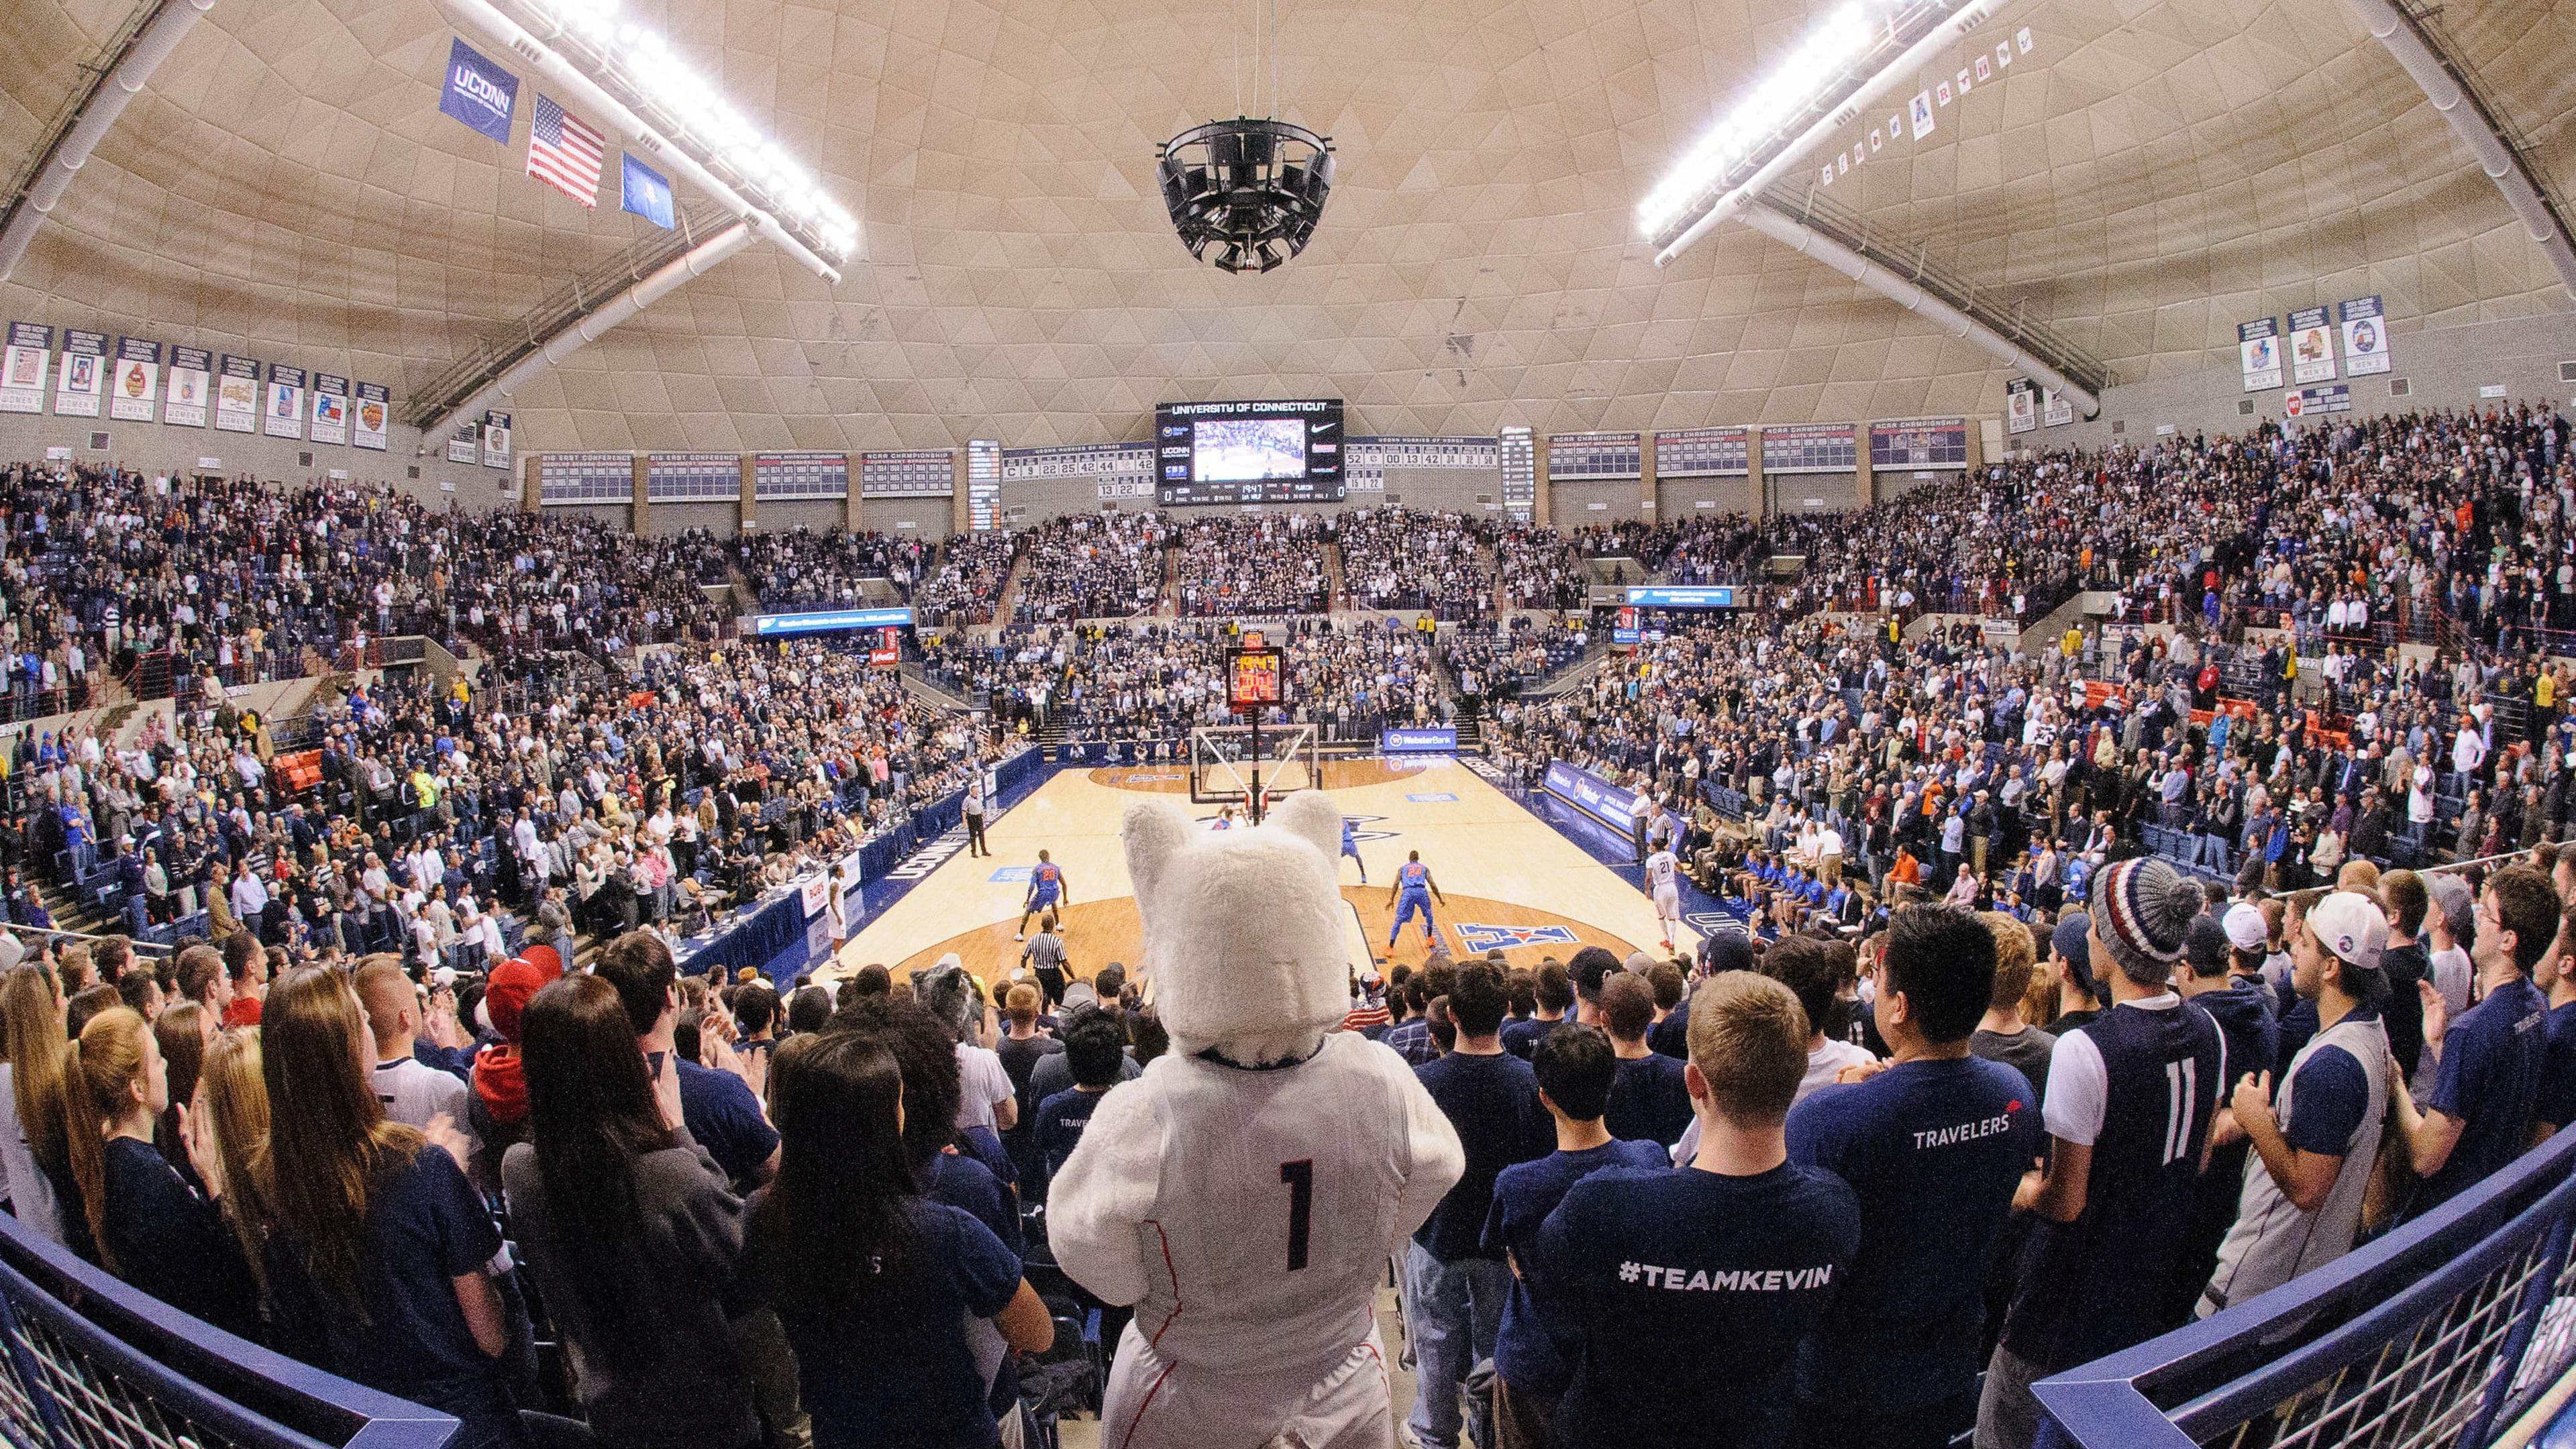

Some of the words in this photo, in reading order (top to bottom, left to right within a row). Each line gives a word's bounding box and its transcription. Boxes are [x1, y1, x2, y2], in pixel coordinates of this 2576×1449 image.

[454, 66, 510, 112] UCONN
[1172, 404, 1234, 415] UNIVERSITY
[1237, 403, 1250, 413] OF
[1253, 402, 1327, 412] CONNECTICUT
[1900, 420, 1959, 428] CHAMPIONSHIP
[1684, 429, 1742, 438] CHAMPIONSHIP
[1348, 455, 1361, 464] 52
[1387, 455, 1400, 463] 00
[1407, 455, 1418, 463] 13
[1426, 455, 1438, 464] 42
[1062, 464, 1075, 473] 25
[1081, 463, 1094, 472] 42
[1100, 462, 1113, 470] 44
[1139, 460, 1152, 469] 42
[1008, 468, 1016, 476] C
[1028, 466, 1033, 475] 9
[1043, 465, 1056, 474] 22
[1370, 479, 1378, 488] 22
[1102, 486, 1112, 495] 13
[1121, 485, 1133, 494] 22
[1243, 484, 1262, 494] 19:47
[1338, 486, 1345, 497] 0
[1165, 490, 1172, 501] 0
[1240, 655, 1275, 672] 19:47
[1404, 735, 1451, 745] WebsterBank
[1582, 783, 1602, 805] Webster
[1659, 861, 1670, 874] 21
[1042, 869, 1055, 882] 20
[1407, 867, 1423, 878] 24
[2162, 1057, 2196, 1167] 11
[1060, 1118, 1089, 1129] TRAVE
[1914, 1114, 2010, 1150] TRAVELERS
[1280, 1157, 1313, 1272] 1
[1618, 1260, 1833, 1292] #TEAMKEVIN
